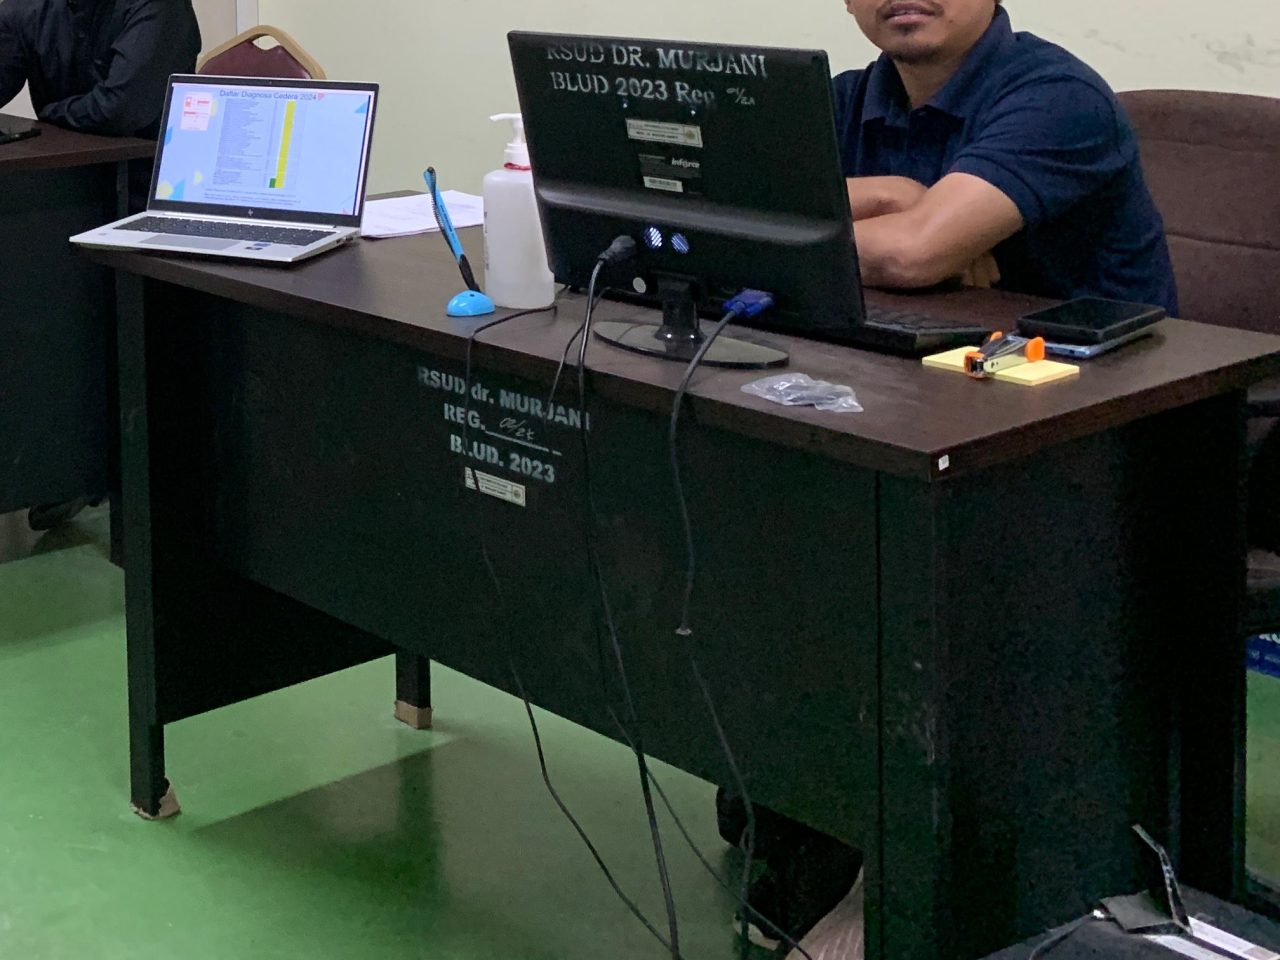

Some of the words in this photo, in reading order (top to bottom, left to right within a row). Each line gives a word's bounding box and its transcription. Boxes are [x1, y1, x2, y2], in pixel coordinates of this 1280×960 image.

[611, 44, 651, 69] DR.
[655, 46, 768, 79] MURJANI
[241, 90, 273, 100] Diagnosa
[549, 71, 609, 95] BLUD
[615, 77, 669, 102] 2023
[417, 365, 466, 395] RSUD
[471, 382, 495, 404] dr.
[499, 388, 590, 431] MURJANI
[443, 402, 486, 431] REG.
[508, 452, 556, 483] 2023
